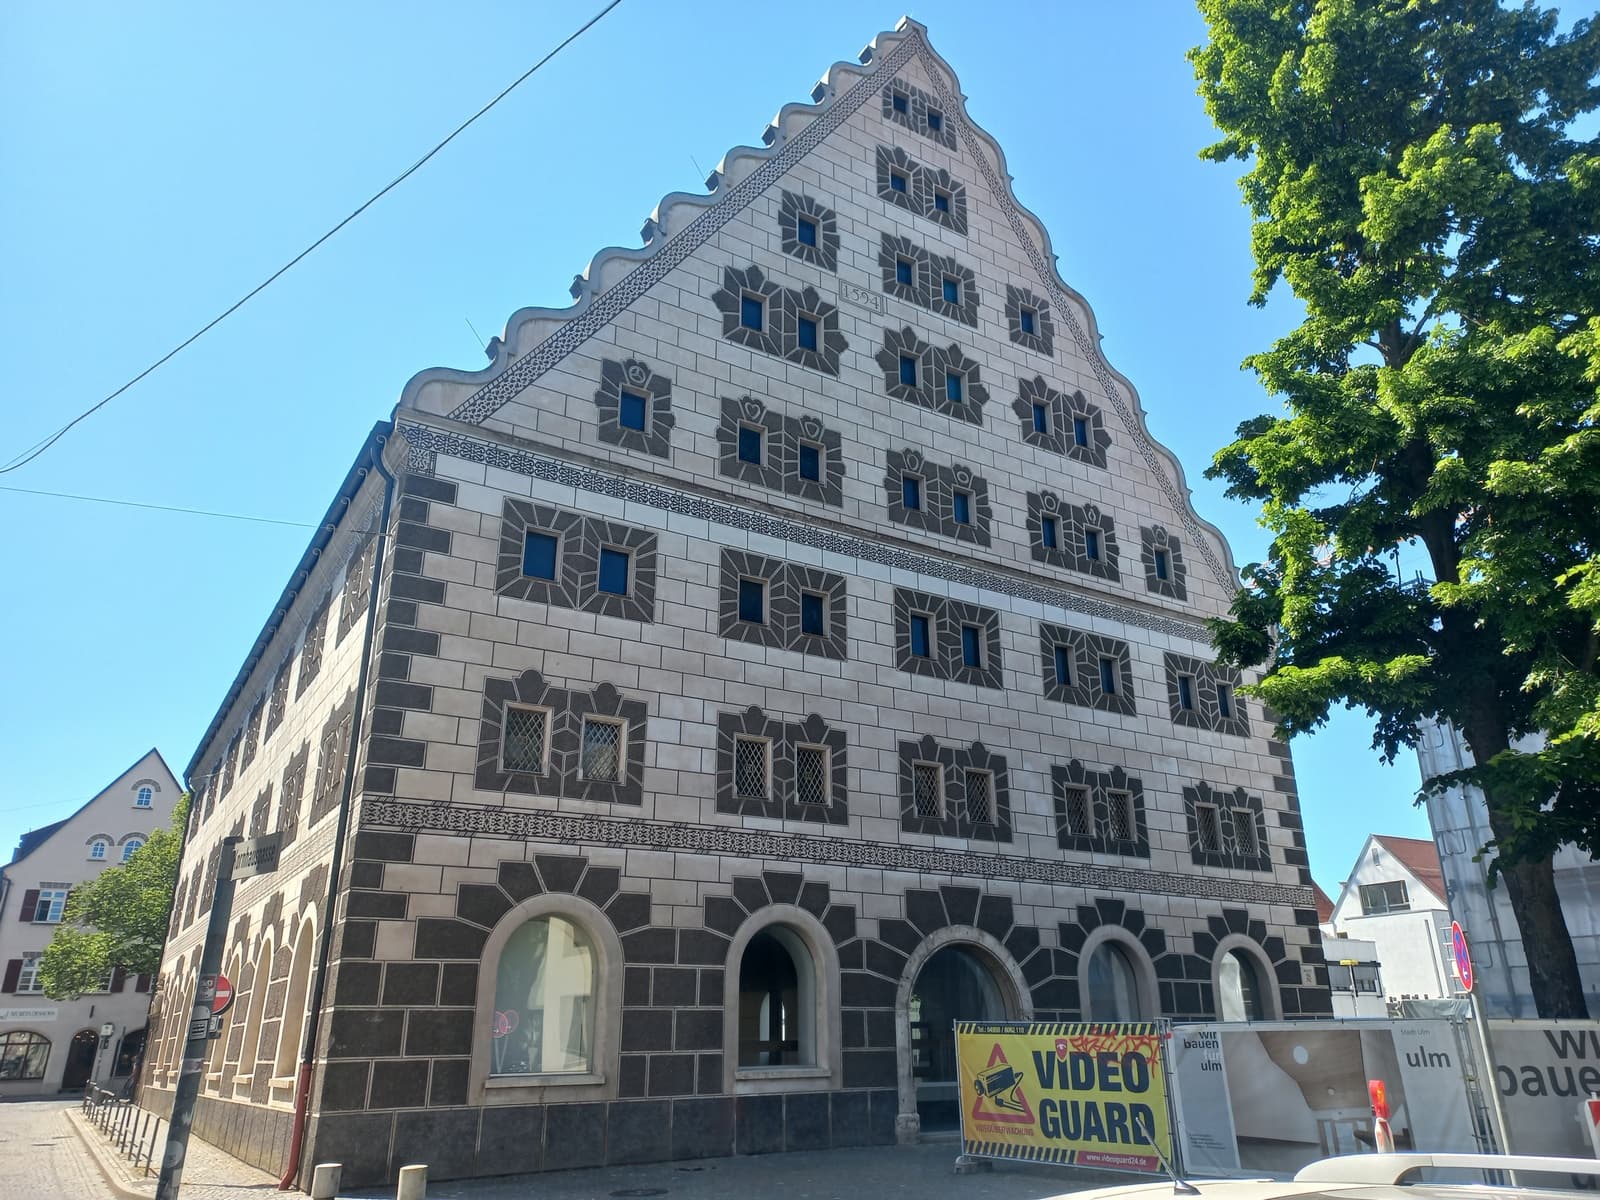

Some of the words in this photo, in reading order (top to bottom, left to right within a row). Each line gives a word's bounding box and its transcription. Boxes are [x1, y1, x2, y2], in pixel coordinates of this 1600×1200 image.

[843, 284, 880, 310] 1594
[1183, 1038, 1219, 1049] bauen
[1200, 1059, 1223, 1072] ulm
[1406, 1046, 1451, 1068] ulm
[1039, 1098, 1156, 1146] GUARD
